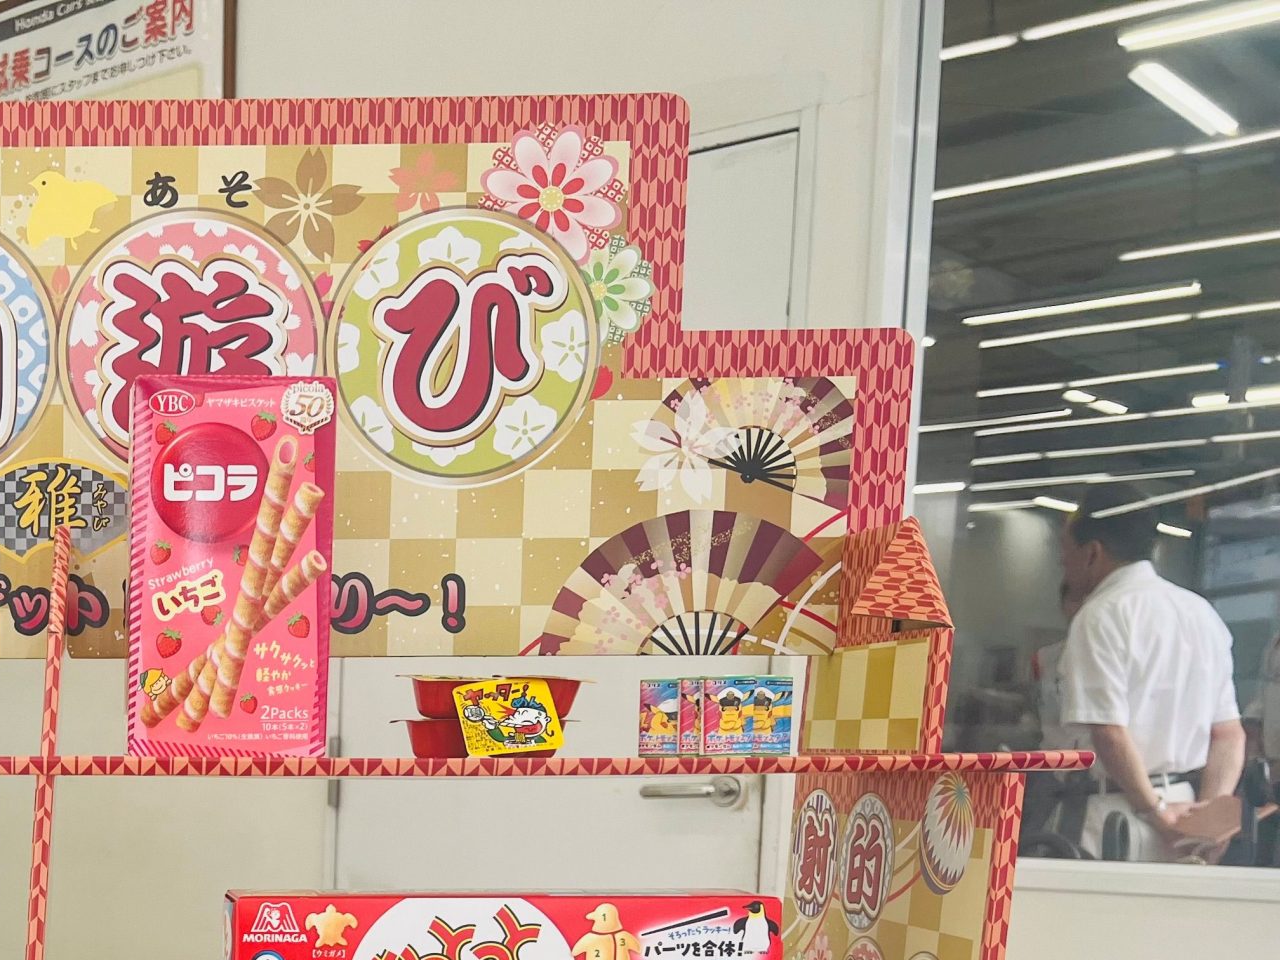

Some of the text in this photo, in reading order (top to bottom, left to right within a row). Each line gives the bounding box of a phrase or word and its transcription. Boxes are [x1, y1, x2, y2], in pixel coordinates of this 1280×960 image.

[14, 9, 55, 33] Honda
[292, 381, 324, 394] picola
[157, 394, 189, 412] YBC
[206, 397, 276, 409] ヤマザキビスケット
[290, 396, 325, 416] 50
[163, 463, 257, 501] ピコラ
[147, 557, 214, 590] Strawberry
[157, 574, 221, 616] いちご
[254, 640, 315, 670] サクサクッと
[256, 667, 291, 682] 軽やか
[243, 933, 308, 943] MORINAGA
[645, 941, 744, 957] パーツを合体!
